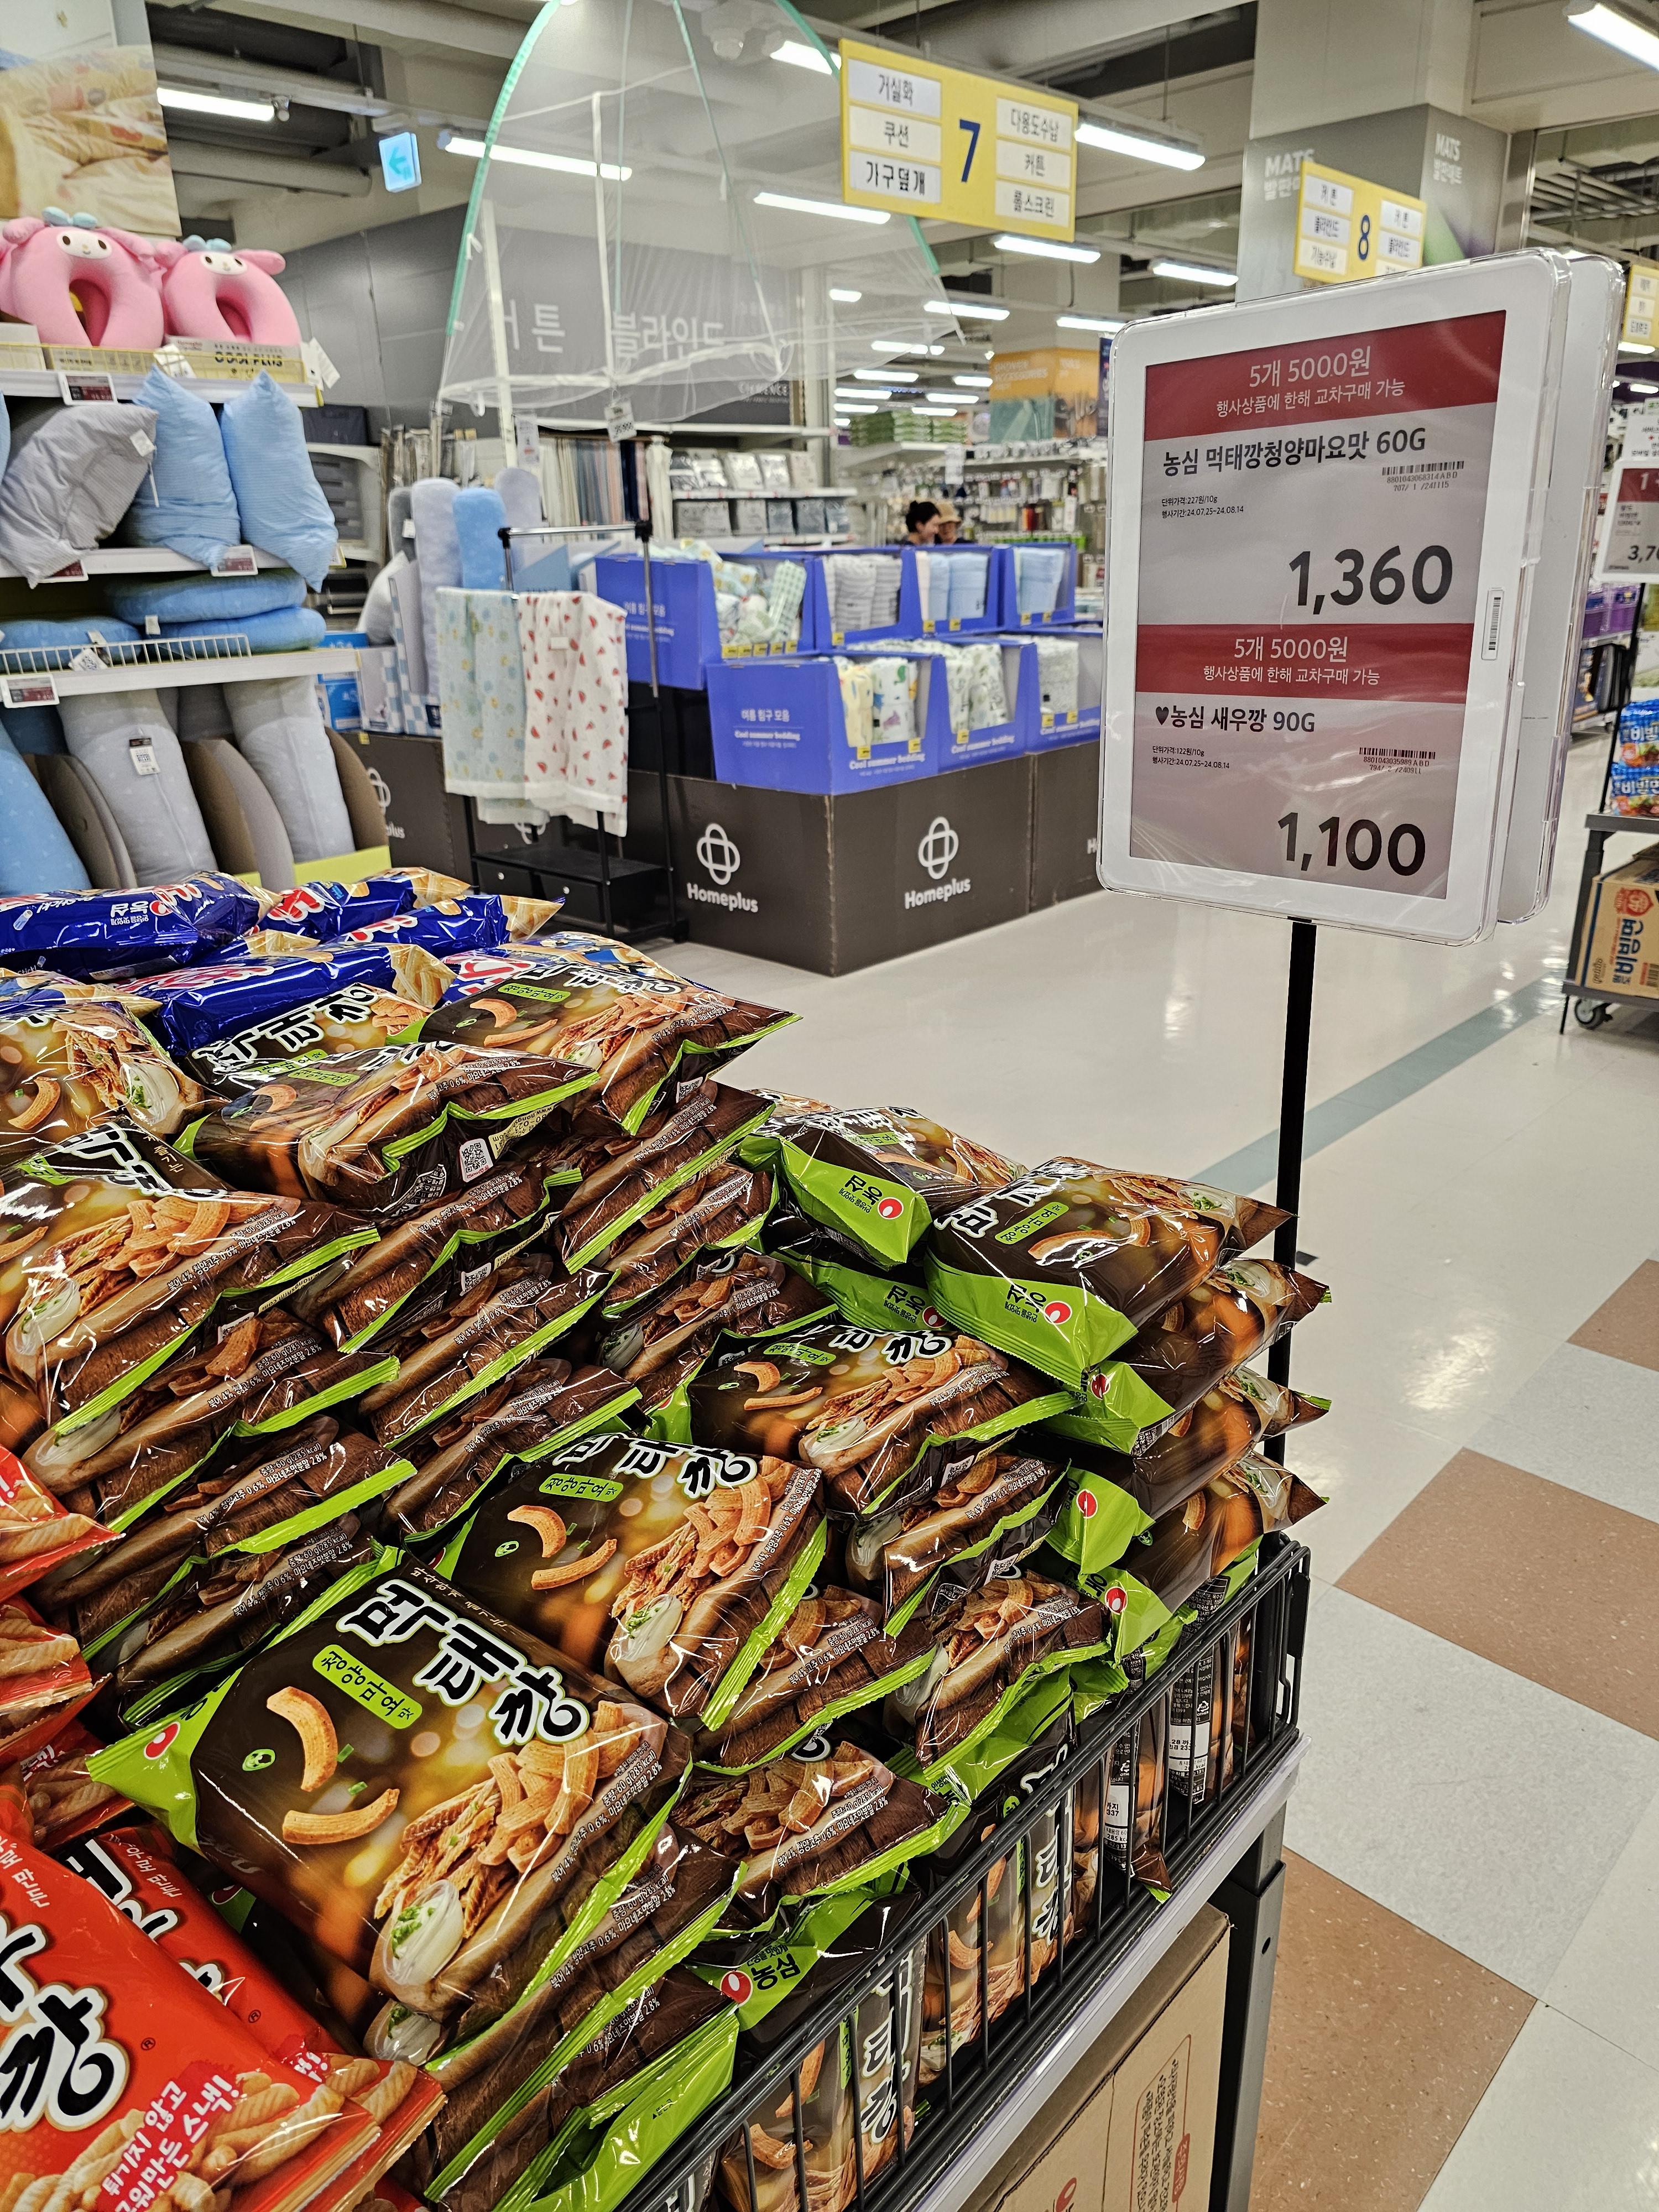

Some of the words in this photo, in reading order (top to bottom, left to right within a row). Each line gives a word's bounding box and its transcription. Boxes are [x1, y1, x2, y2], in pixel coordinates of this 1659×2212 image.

[878, 74, 913, 107] 거실화
[883, 121, 909, 148] 쿠션
[959, 118, 980, 182] 7
[867, 161, 925, 196] 가구덮개
[1024, 154, 1044, 177] 커튼
[1358, 215, 1371, 260] 8
[1249, 358, 1281, 388] 5개
[1287, 345, 1371, 383] 5000원
[1216, 390, 1280, 418] 행사상품에
[1284, 389, 1311, 411] 한해
[1314, 383, 1371, 405] 교차구매
[1375, 377, 1406, 398] 가능
[1163, 448, 1198, 477] 농심
[1205, 431, 1370, 473] 먹태깡청양마요맛
[1376, 427, 1426, 455] 60G
[1288, 545, 1453, 615] 1,360
[1234, 635, 1264, 661] 5개
[1270, 635, 1349, 663] 5000원
[1203, 665, 1264, 683] 행사상품에
[1267, 666, 1292, 684] 한해
[1295, 667, 1349, 685] 교차구매
[1353, 668, 1380, 686] 가능
[1210, 708, 1267, 732] 새우깡
[1272, 711, 1316, 733] 90G
[1277, 812, 1426, 877] 1,100
[110, 900, 149, 919] 농심
[686, 882, 759, 914] Homeplus
[904, 875, 971, 911] Homeplus
[838, 1187, 855, 1203] 맛있게
[844, 1173, 883, 1206] 농심
[854, 1199, 872, 1214] 인생을
[886, 1284, 926, 1316] 농심
[1006, 1283, 1047, 1313] 농심
[265, 1463, 312, 1485] 마요네즈맛분말
[311, 1451, 328, 1465] 2.8%
[553, 1432, 757, 1499] 먹태깡
[546, 1476, 618, 1498] 청양마요맛
[336, 1578, 592, 1747] 먹태깡
[317, 1650, 416, 1724] 청양마요맛
[607, 1778, 648, 1816] 마요네즈맛분말
[647, 1760, 662, 1780] 2.8%
[617, 1897, 661, 1932] 마요네즈맛분말
[750, 1952, 801, 1991] 농심
[182, 2074, 240, 2144] 스낵!
[101, 2130, 153, 2197] 튀기지
[144, 2080, 187, 2133] 않고
